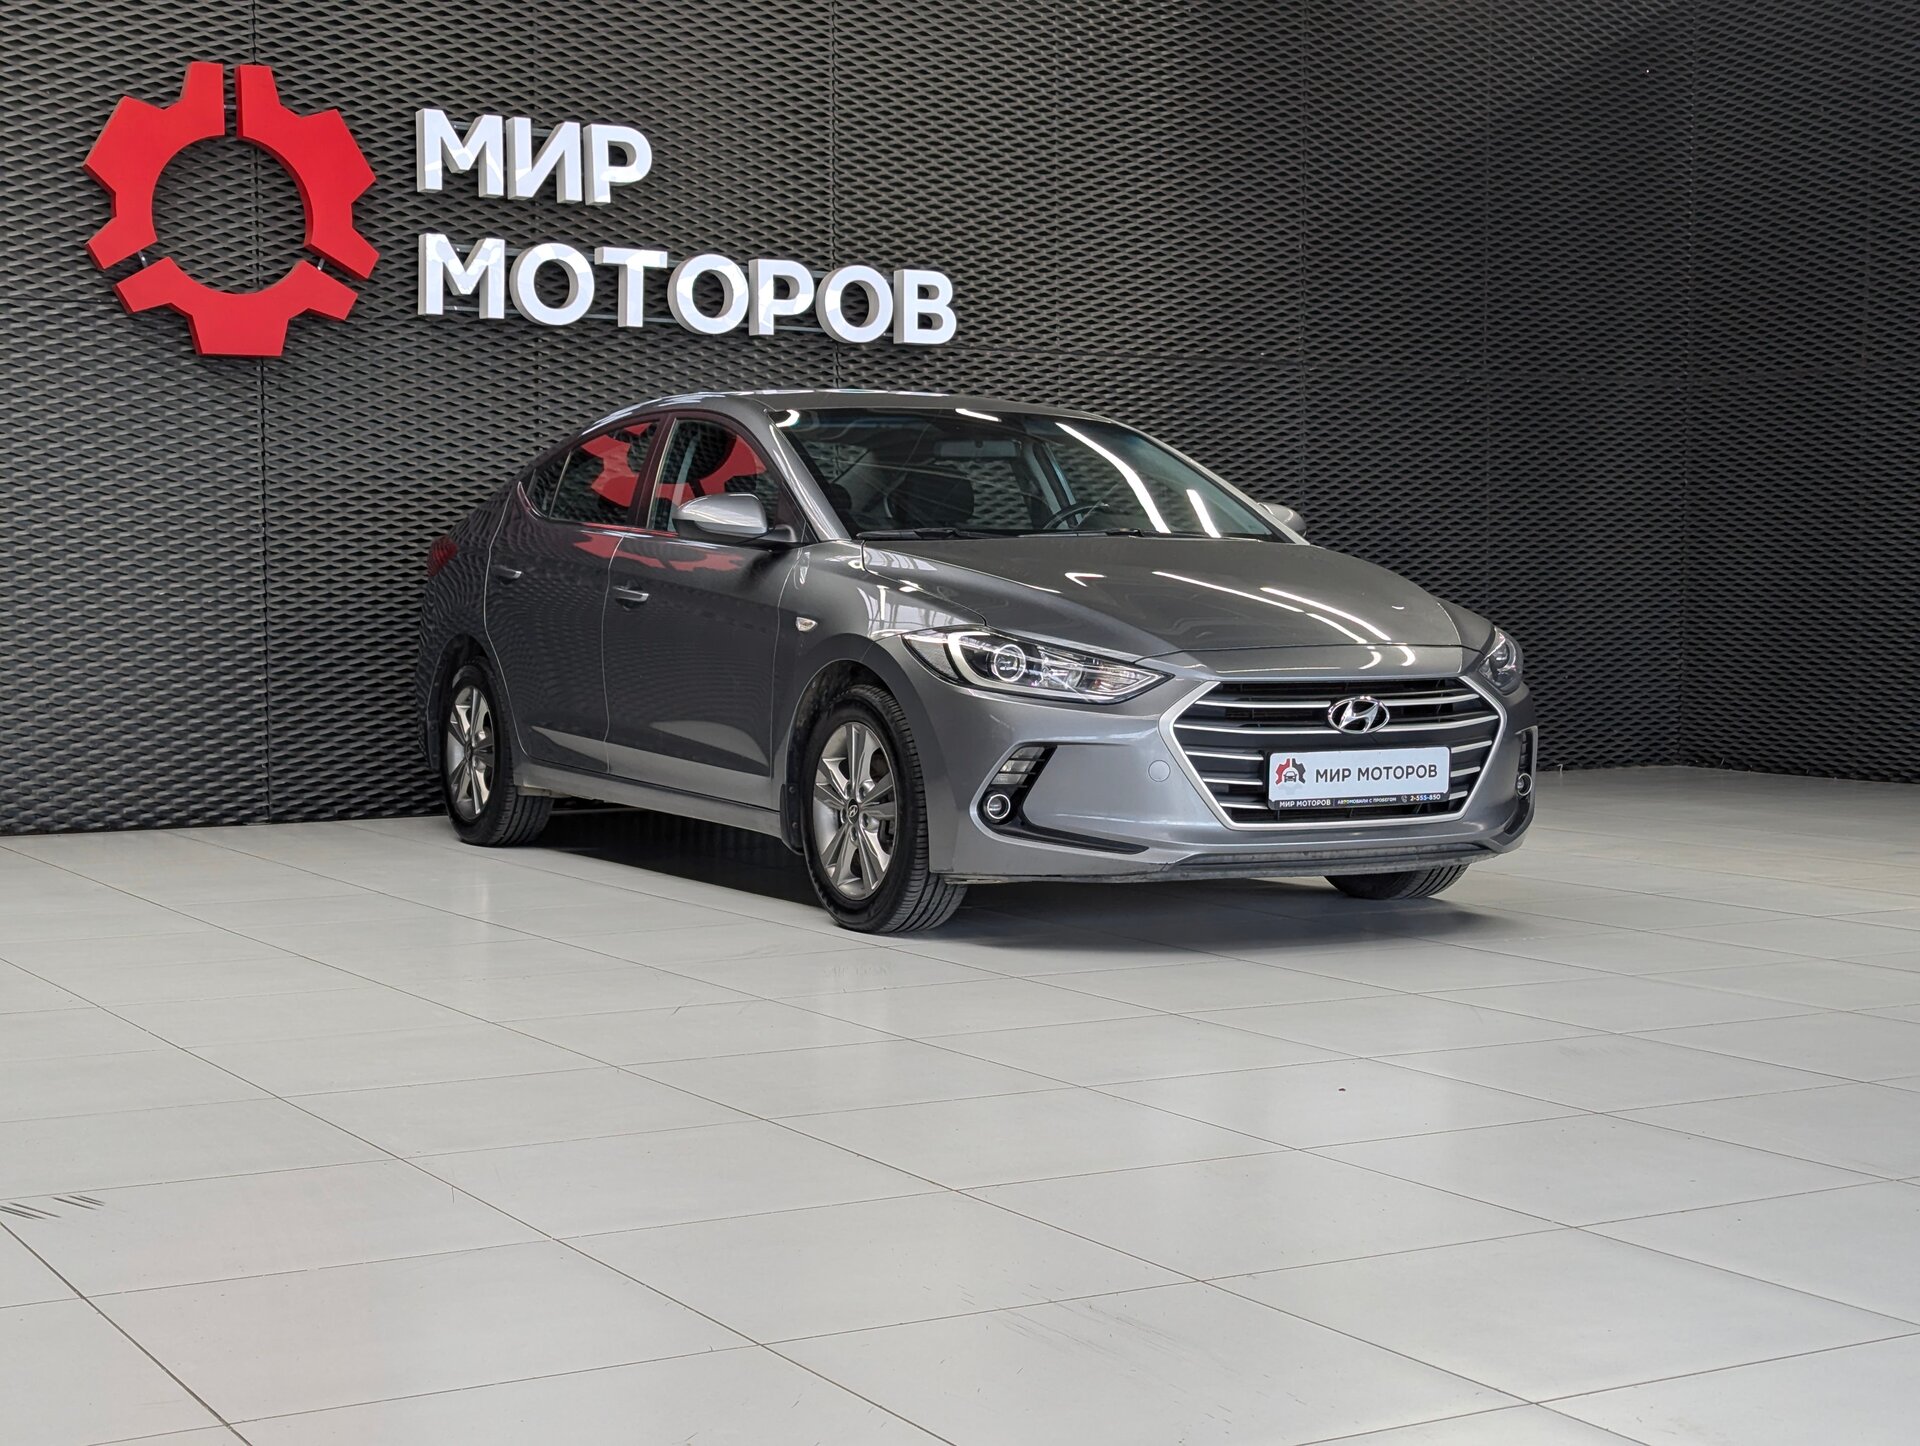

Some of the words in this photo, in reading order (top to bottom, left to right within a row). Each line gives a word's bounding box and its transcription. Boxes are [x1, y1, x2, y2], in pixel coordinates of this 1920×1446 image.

[415, 107, 653, 206] МИР
[417, 232, 958, 345] МОТОРОВ
[1315, 767, 1352, 783] МИР
[1357, 764, 1438, 782] МОТОРОВ
[1279, 800, 1295, 808] МИР
[1296, 799, 1331, 807] МОТОРОВ
